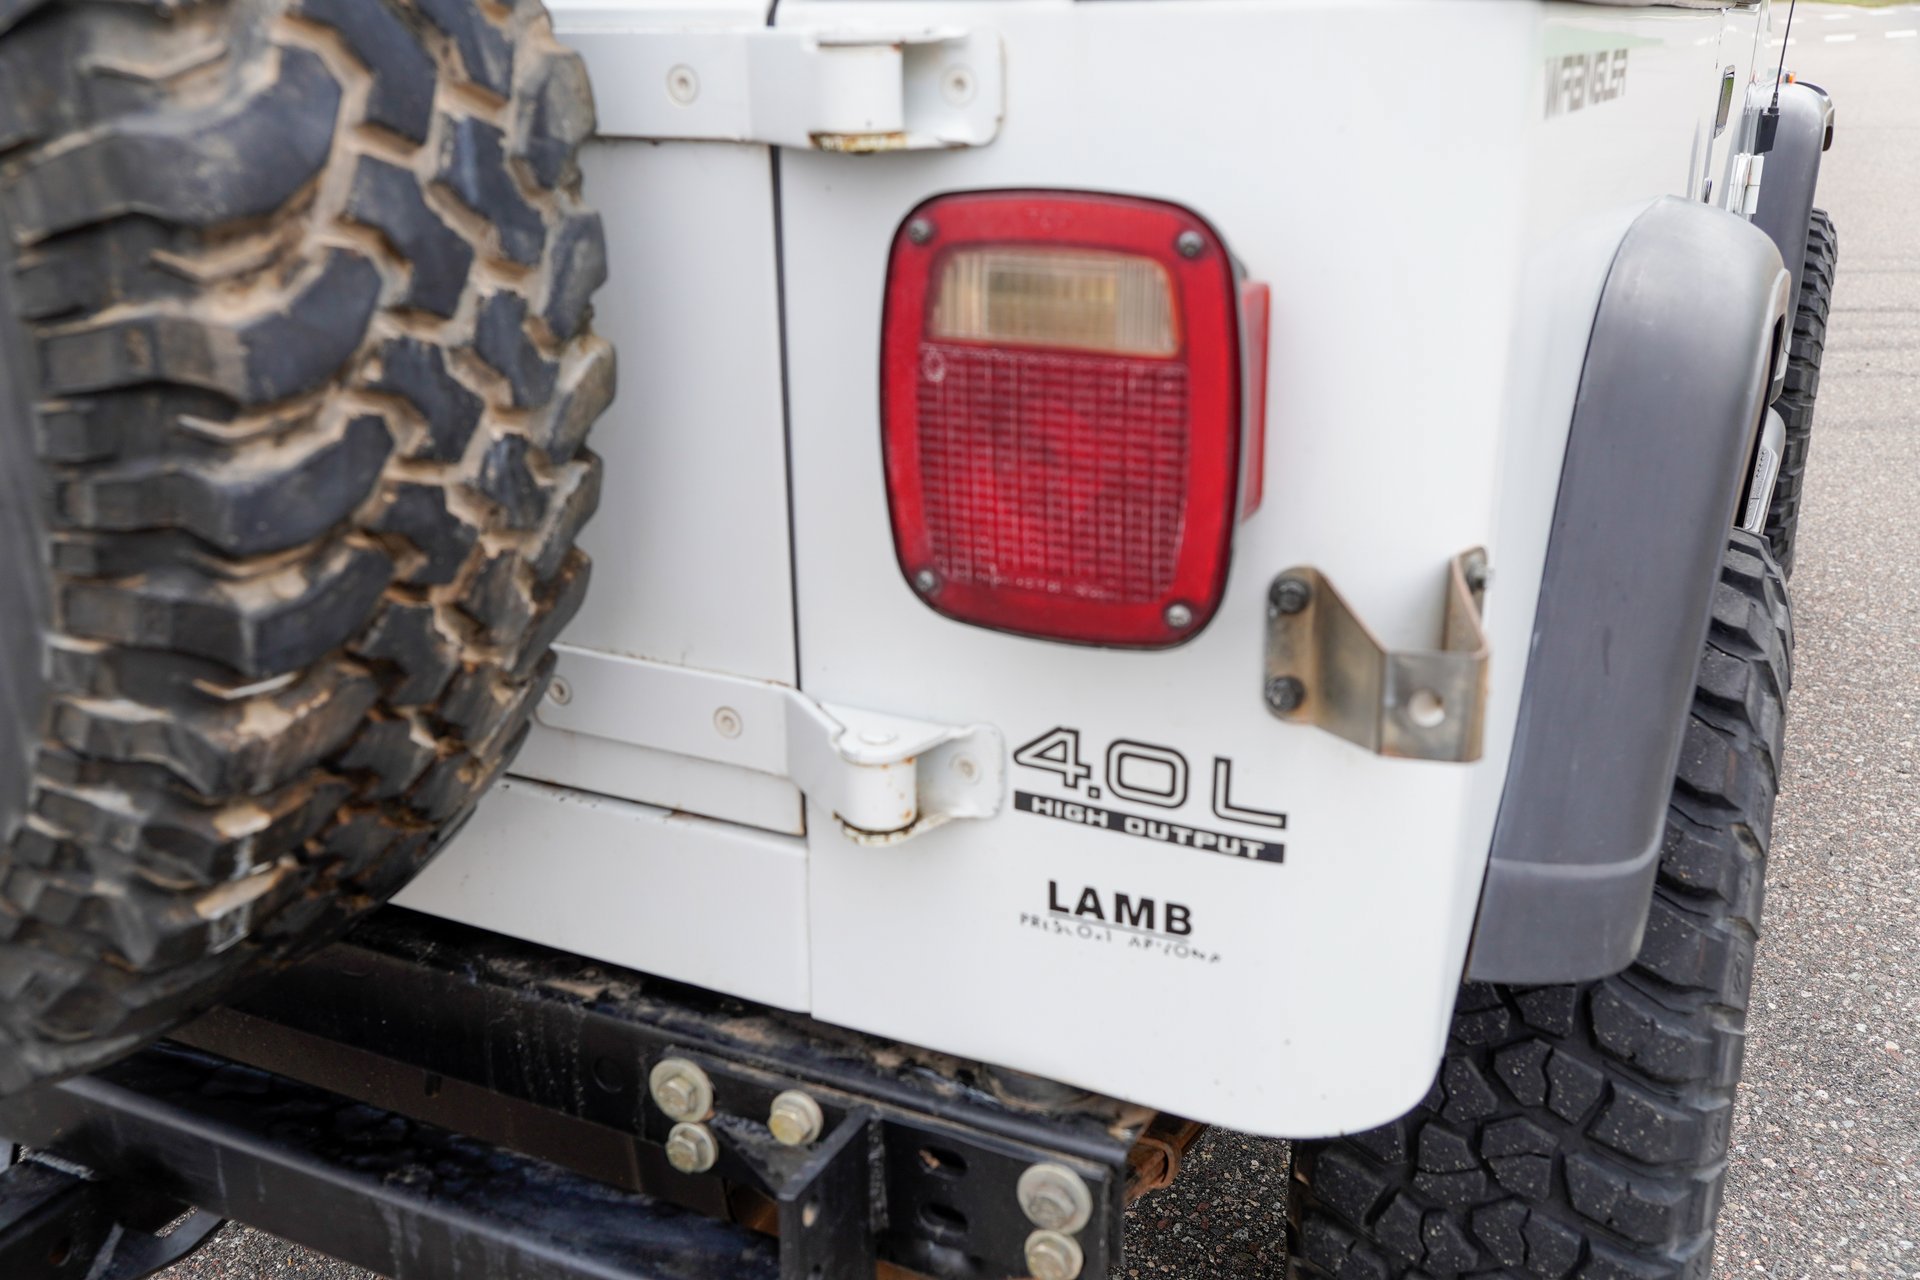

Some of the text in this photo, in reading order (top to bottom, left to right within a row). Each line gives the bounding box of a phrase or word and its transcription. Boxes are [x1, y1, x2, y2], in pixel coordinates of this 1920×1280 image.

[1030, 796, 1266, 860] HIGH OUTPUT
[1048, 879, 1193, 937] LAMB
